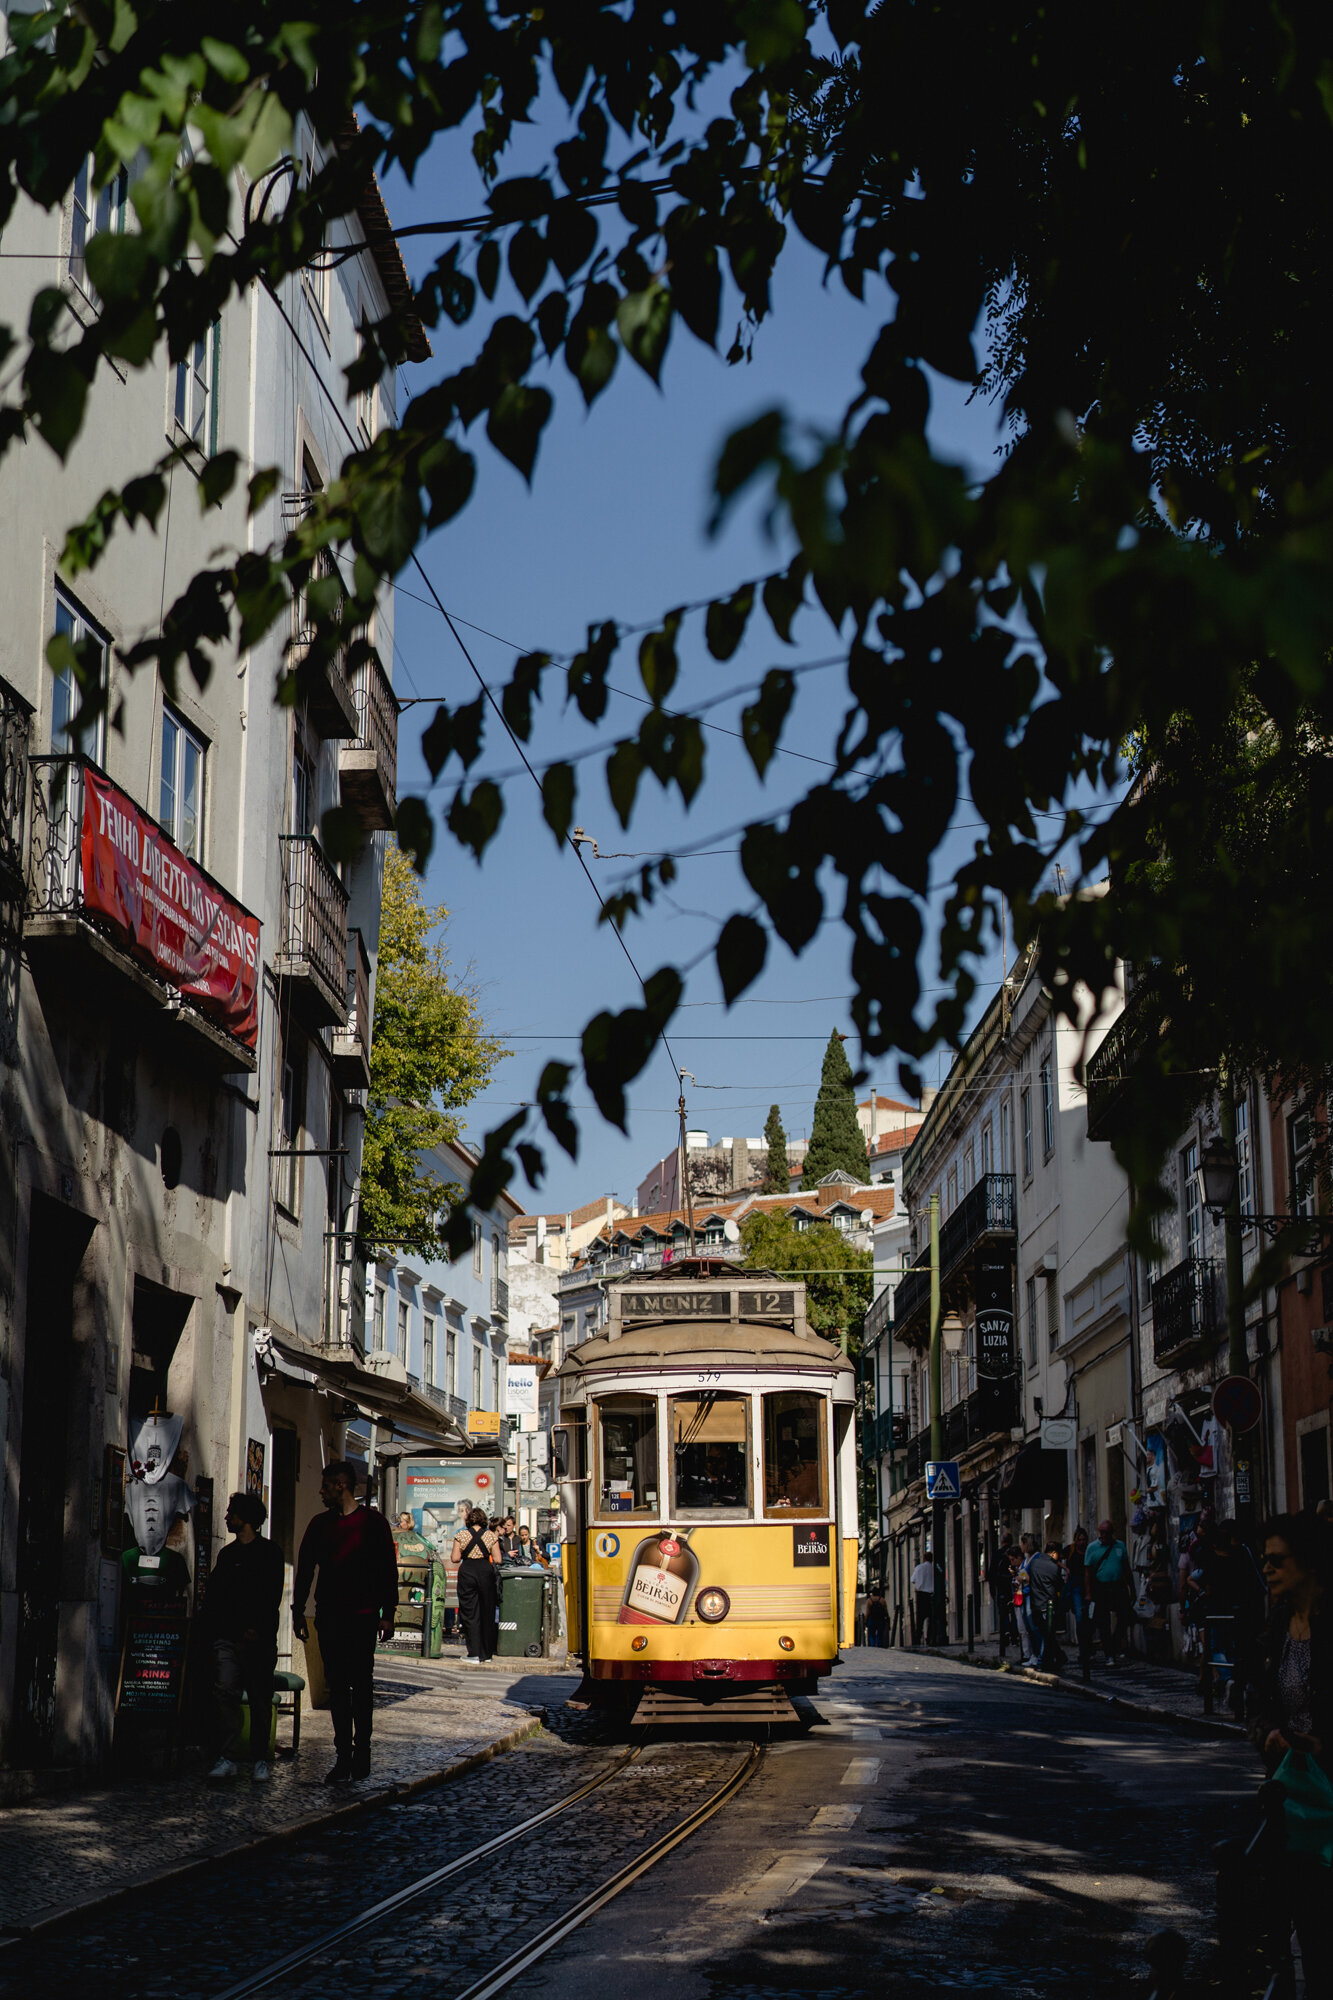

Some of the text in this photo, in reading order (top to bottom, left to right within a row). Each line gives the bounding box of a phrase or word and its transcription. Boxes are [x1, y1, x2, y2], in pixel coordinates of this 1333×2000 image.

[97, 791, 139, 867] TENHO
[142, 834, 189, 910] DIREITO
[191, 882, 205, 926] AO
[753, 1293, 781, 1312] 12
[980, 1320, 1010, 1334] SANTA
[983, 1335, 1008, 1346] LUZIA
[508, 1377, 533, 1387] hello
[698, 1371, 721, 1383] 579
[550, 1545, 559, 1557] P
[797, 1543, 828, 1554] BEIRÃO
[635, 1579, 679, 1605] BEIRÃO
[136, 1669, 170, 1680] DRINKS
